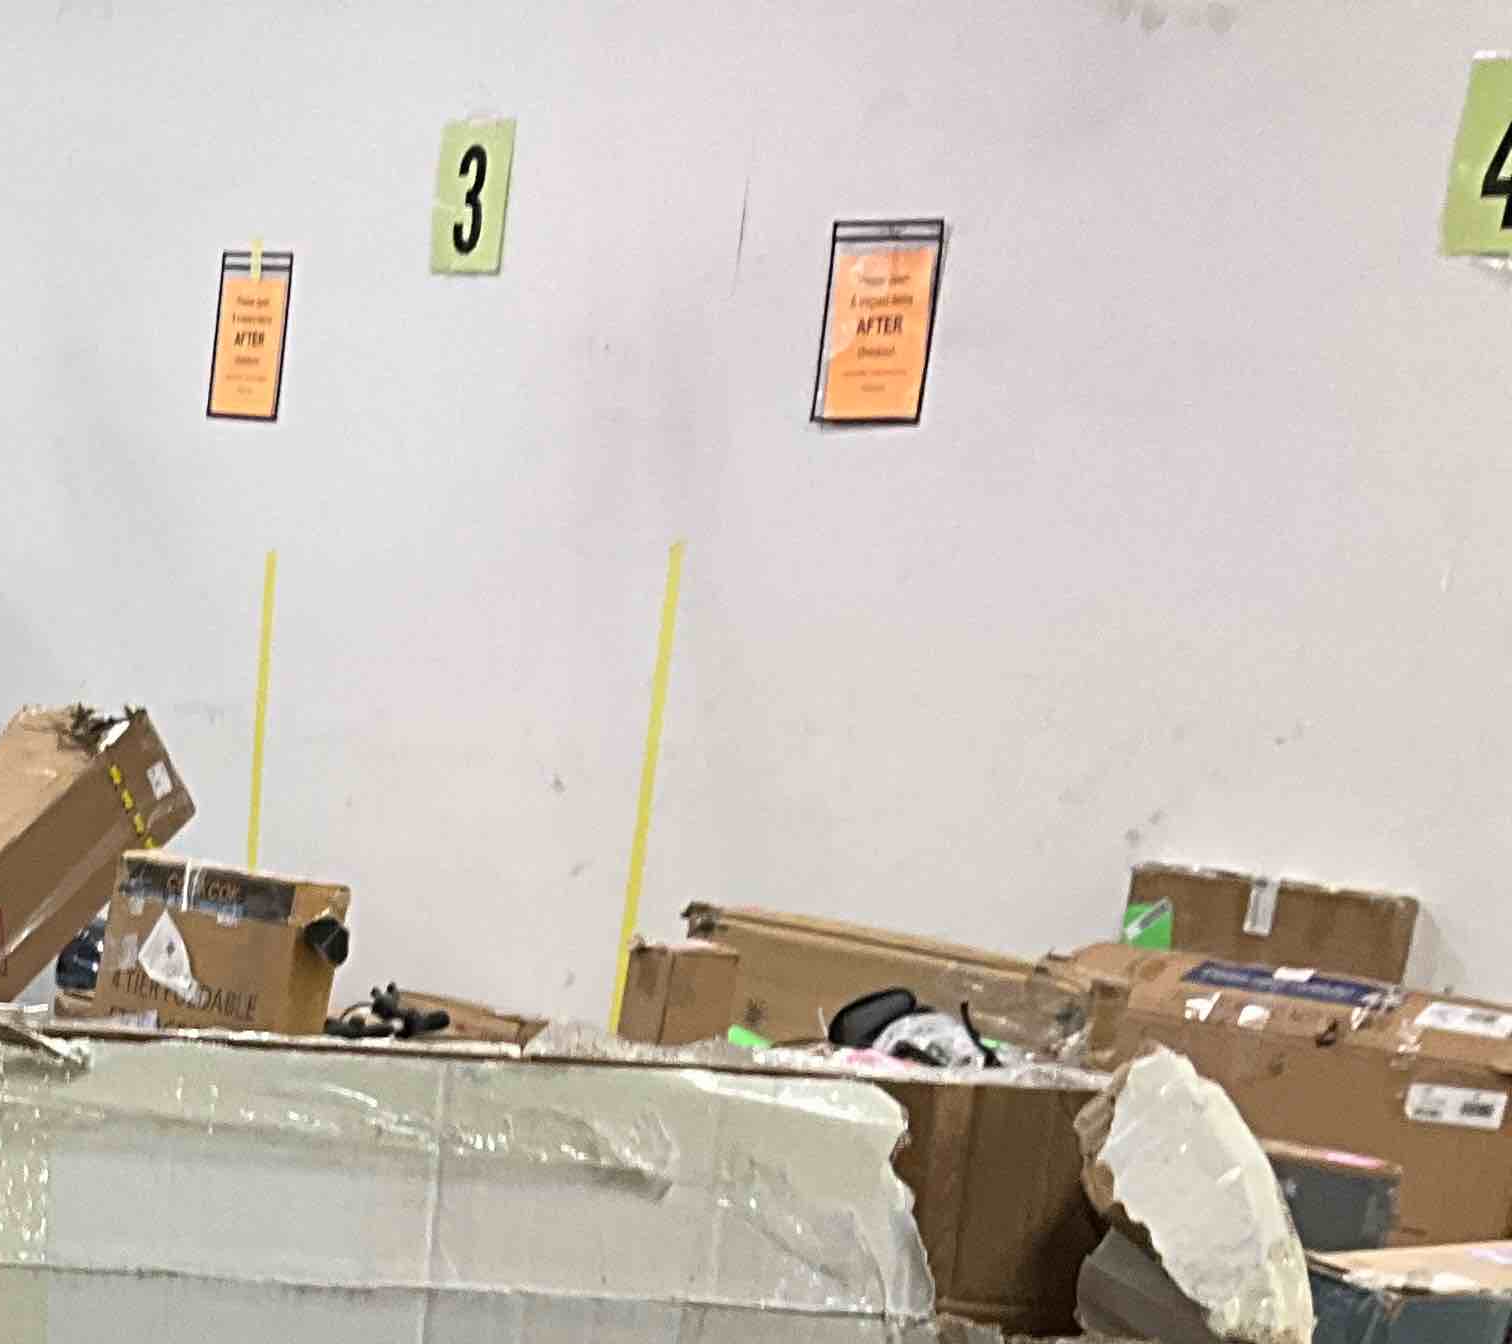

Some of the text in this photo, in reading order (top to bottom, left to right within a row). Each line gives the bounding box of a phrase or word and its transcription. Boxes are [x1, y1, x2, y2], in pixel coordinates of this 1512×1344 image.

[452, 144, 487, 254] 3
[1481, 120, 1512, 228] 4
[234, 331, 265, 347] AFTER
[855, 314, 903, 336] AFTER
